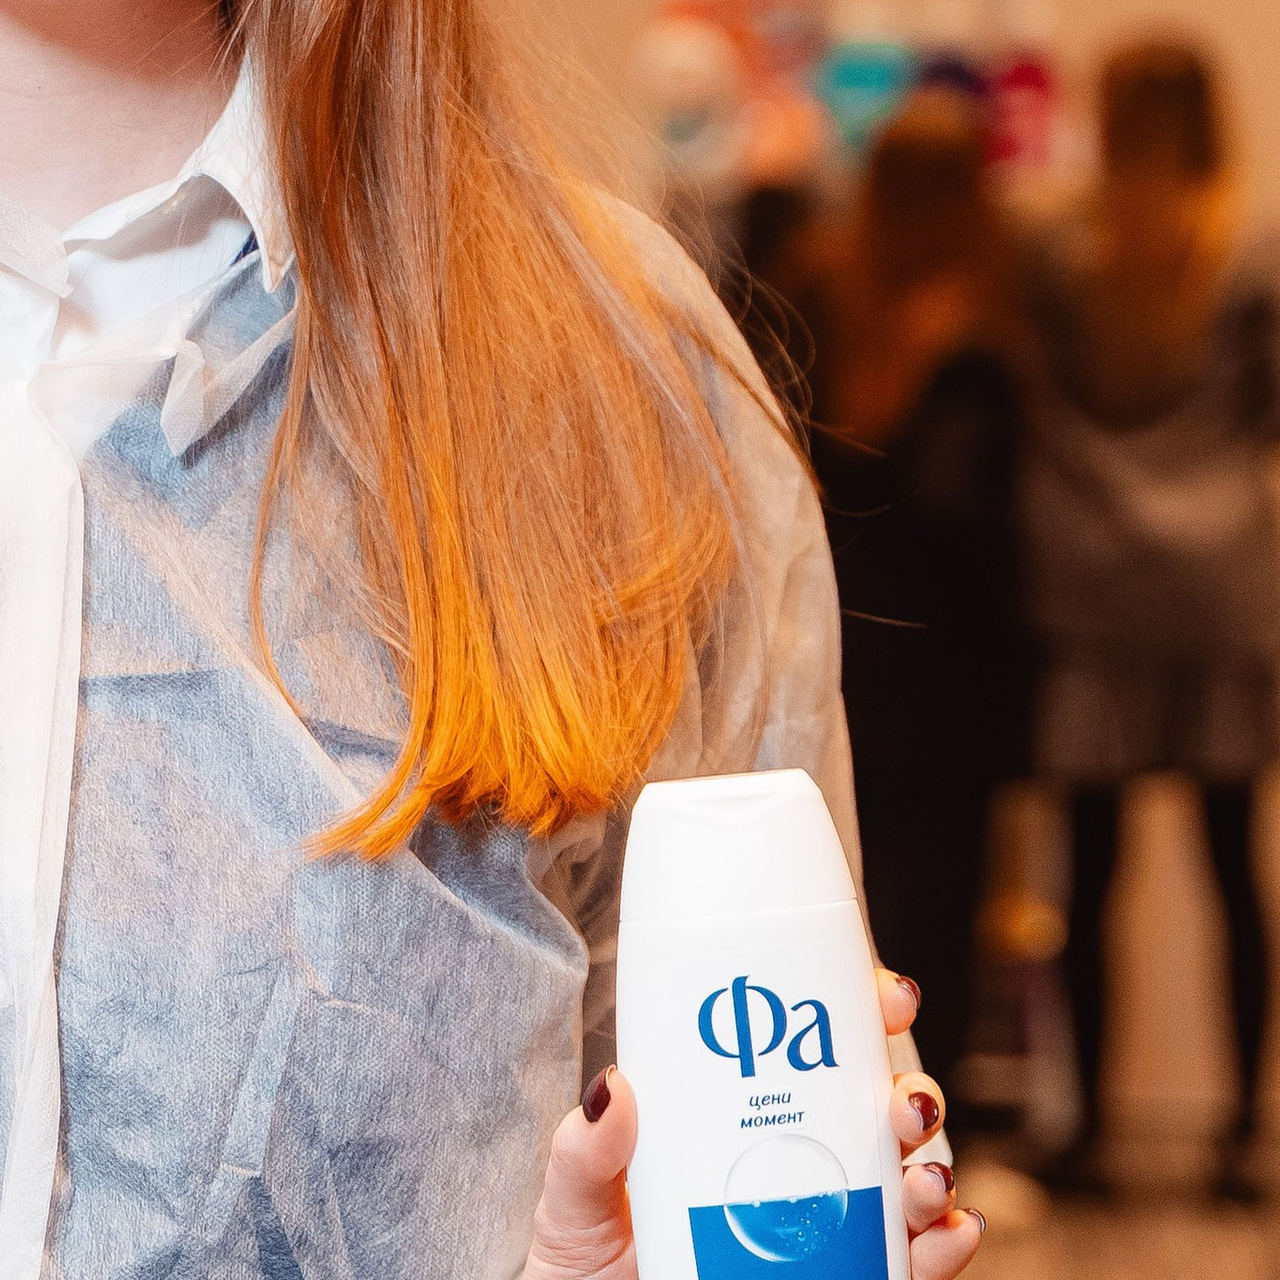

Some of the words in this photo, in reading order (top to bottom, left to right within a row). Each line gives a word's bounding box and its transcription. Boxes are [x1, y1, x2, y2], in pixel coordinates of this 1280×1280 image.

[697, 974, 841, 1078] Фа
[748, 1091, 792, 1111] цени
[740, 1111, 805, 1129] момент
